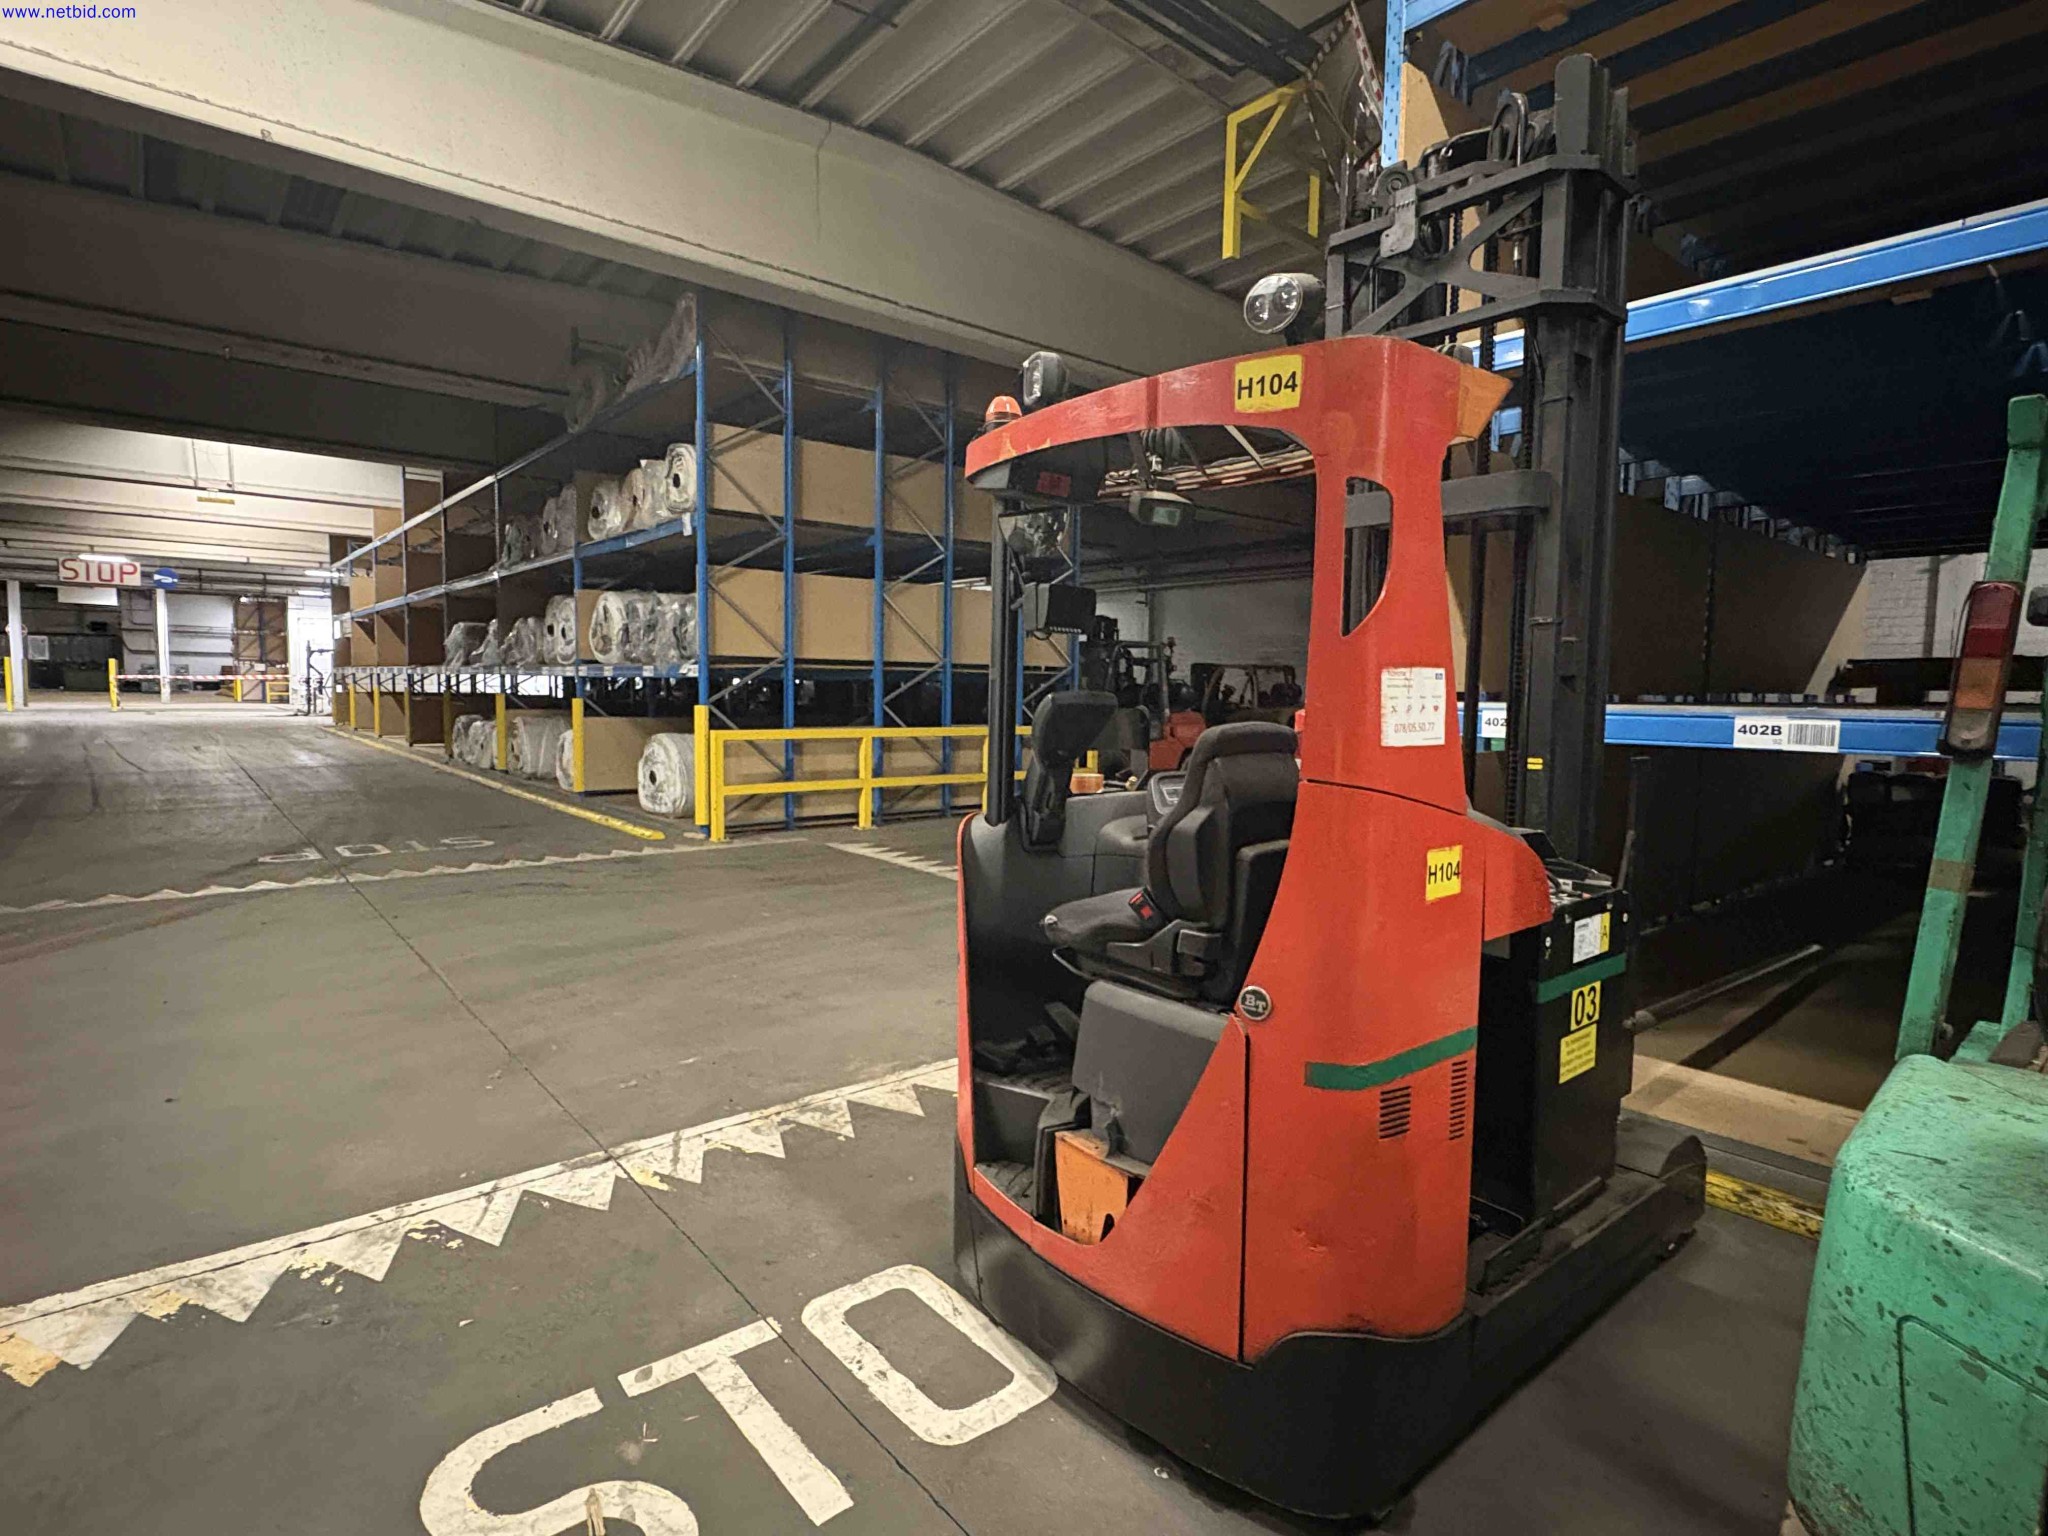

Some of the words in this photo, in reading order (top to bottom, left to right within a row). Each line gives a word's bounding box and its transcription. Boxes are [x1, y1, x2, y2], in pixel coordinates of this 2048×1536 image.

[1237, 370, 1299, 400] H104
[60, 558, 138, 583] STOP
[1737, 724, 1783, 736] 402B
[1428, 860, 1461, 885] H104
[1244, 993, 1267, 1013] BT
[1574, 985, 1597, 1027] 03
